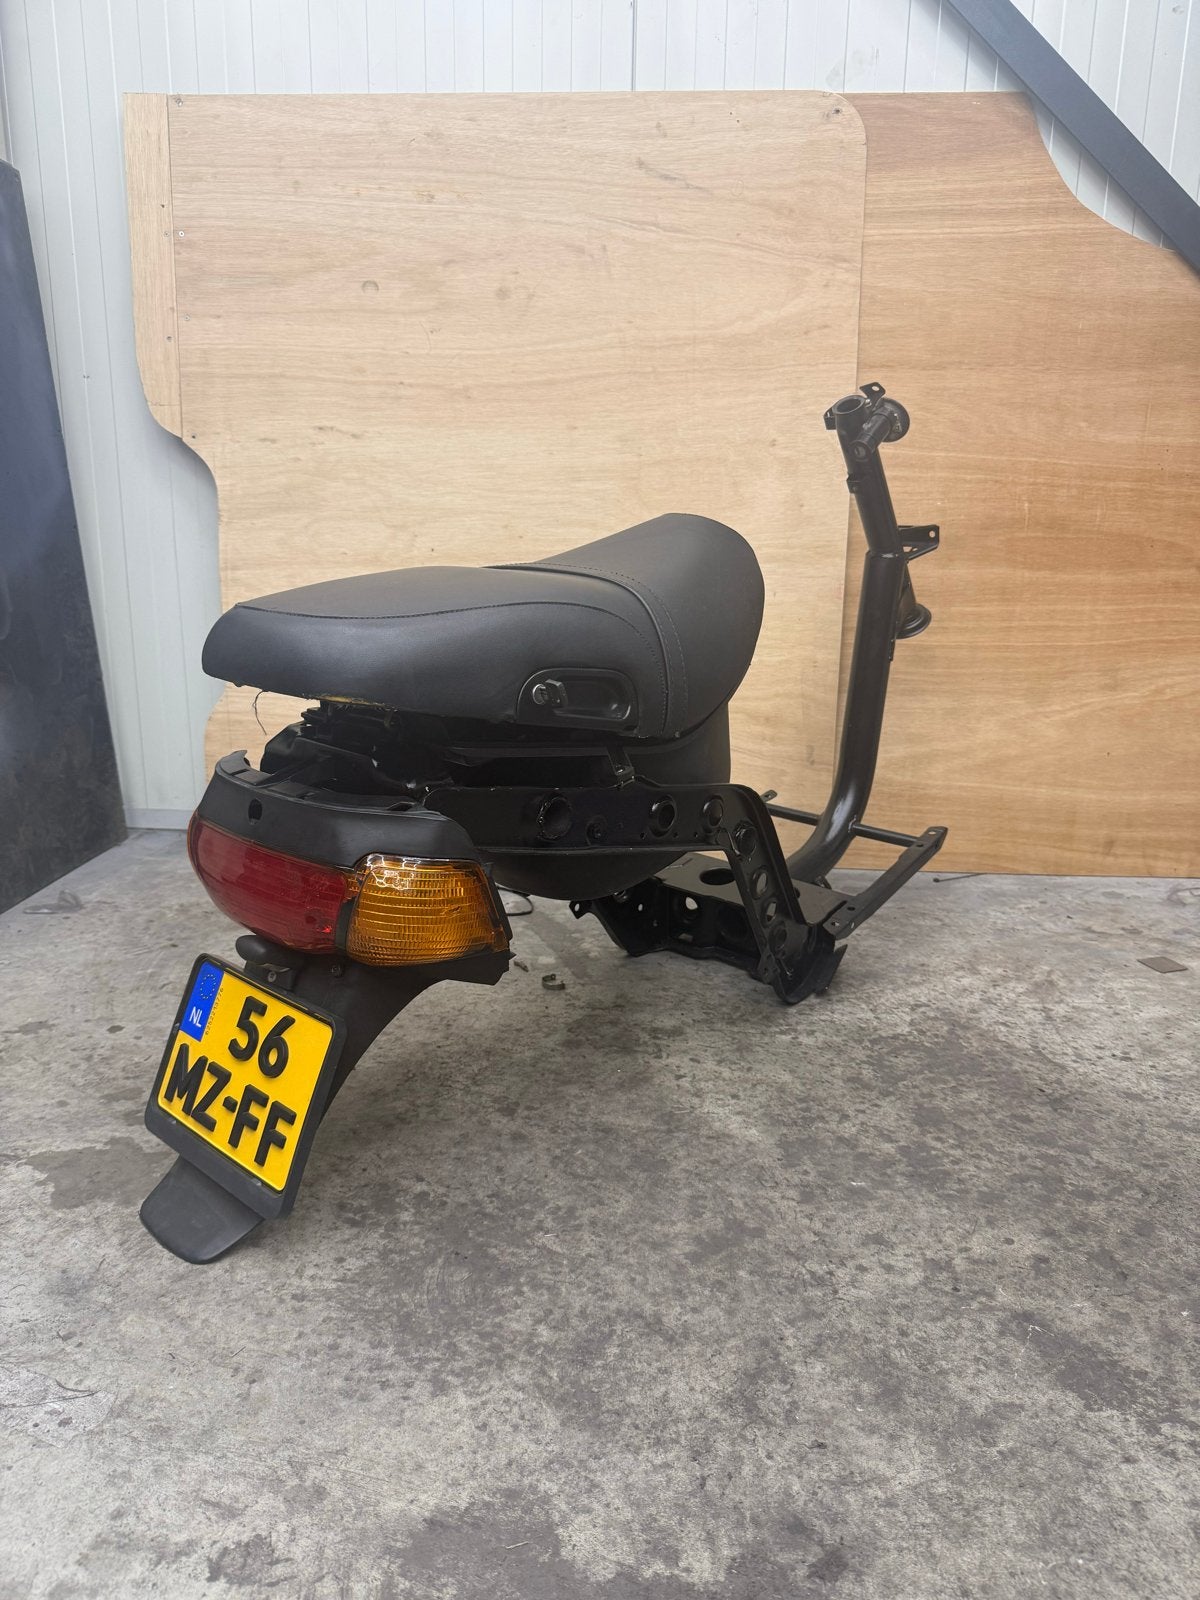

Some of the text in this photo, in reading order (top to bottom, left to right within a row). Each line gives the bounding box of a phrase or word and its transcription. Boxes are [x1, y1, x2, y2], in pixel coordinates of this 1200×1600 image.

[189, 1006, 202, 1028] NL
[228, 996, 296, 1078] 56
[164, 1043, 297, 1168] MZ-FF
